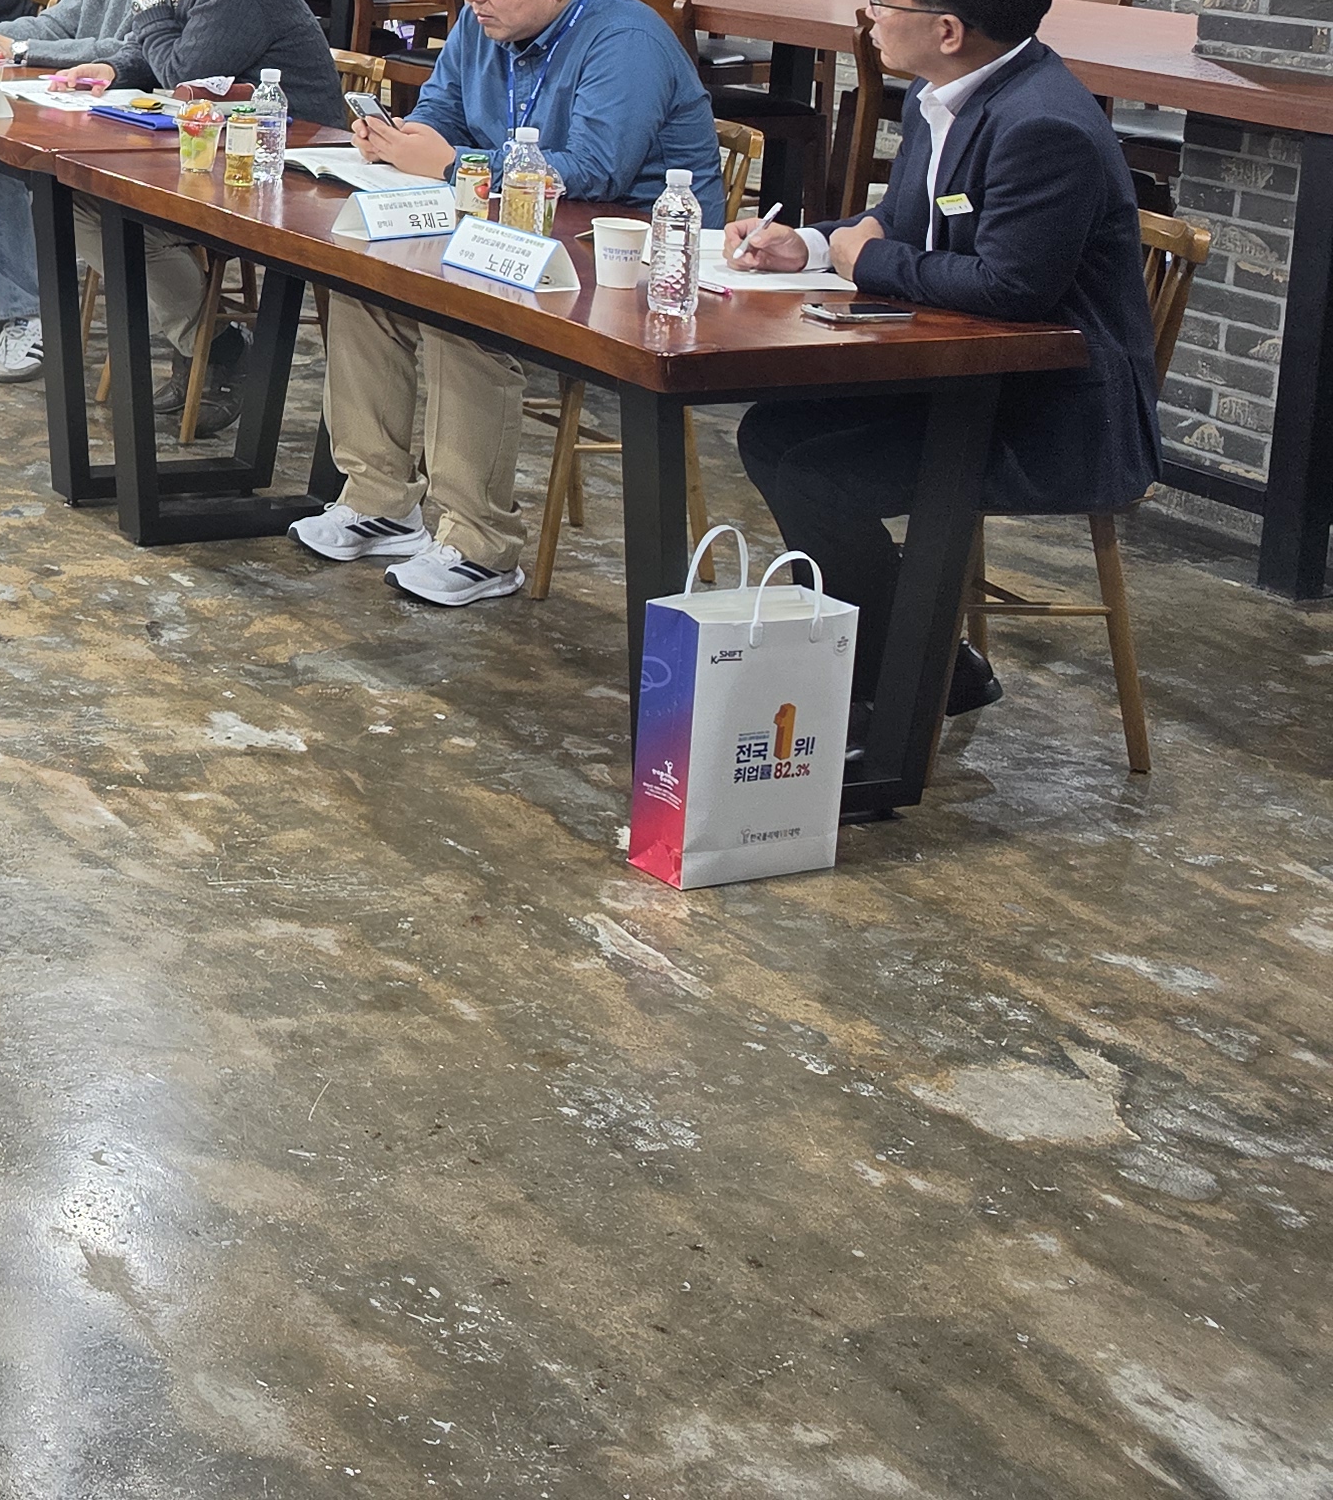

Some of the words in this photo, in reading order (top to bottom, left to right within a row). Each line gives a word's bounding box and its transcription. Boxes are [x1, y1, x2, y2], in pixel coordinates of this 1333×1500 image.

[408, 211, 450, 230] 육제근
[485, 253, 530, 282] 노태정
[735, 741, 769, 764] 전국
[794, 736, 816, 758] 위!
[773, 761, 811, 780] 82.3%
